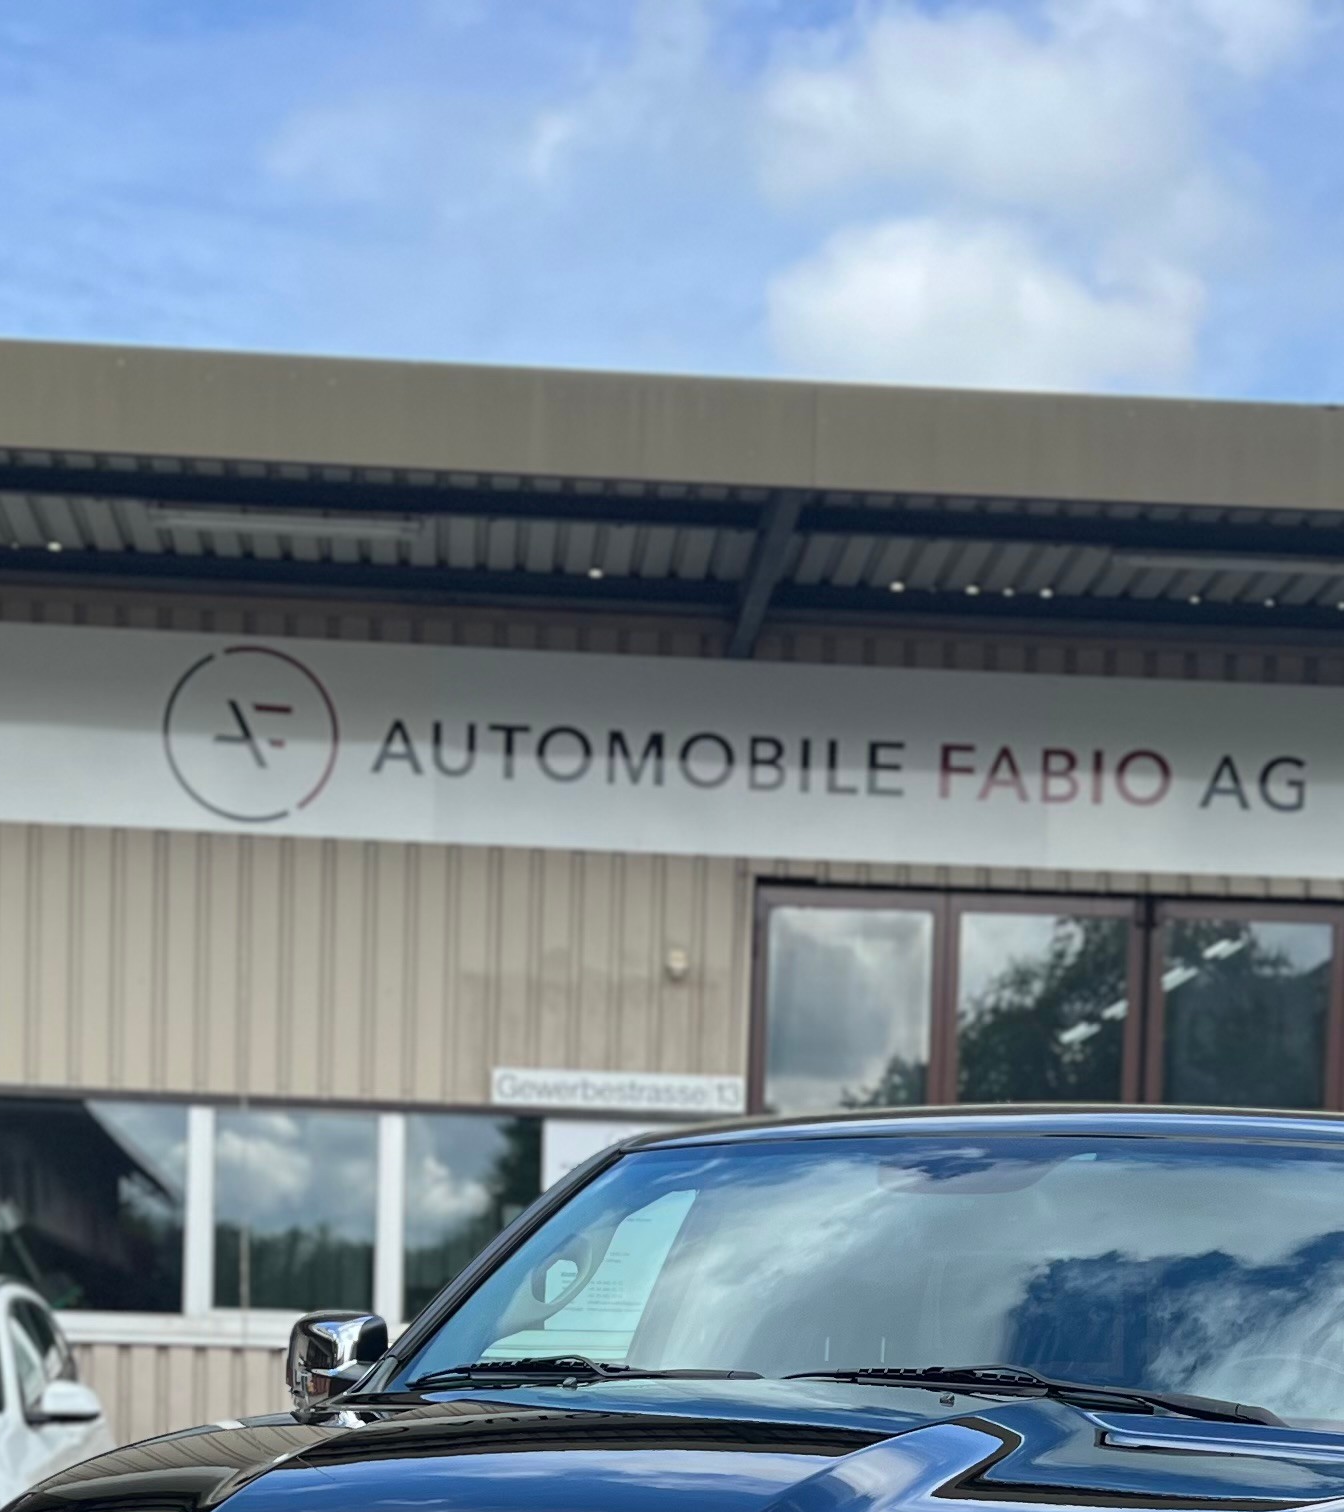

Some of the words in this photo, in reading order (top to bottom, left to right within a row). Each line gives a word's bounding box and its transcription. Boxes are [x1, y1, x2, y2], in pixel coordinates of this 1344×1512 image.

[370, 718, 907, 797] AUTOMOBILE
[938, 743, 1173, 807] FABIO
[1198, 754, 1308, 813] AG
[497, 1072, 706, 1105] Gewerbestrasse
